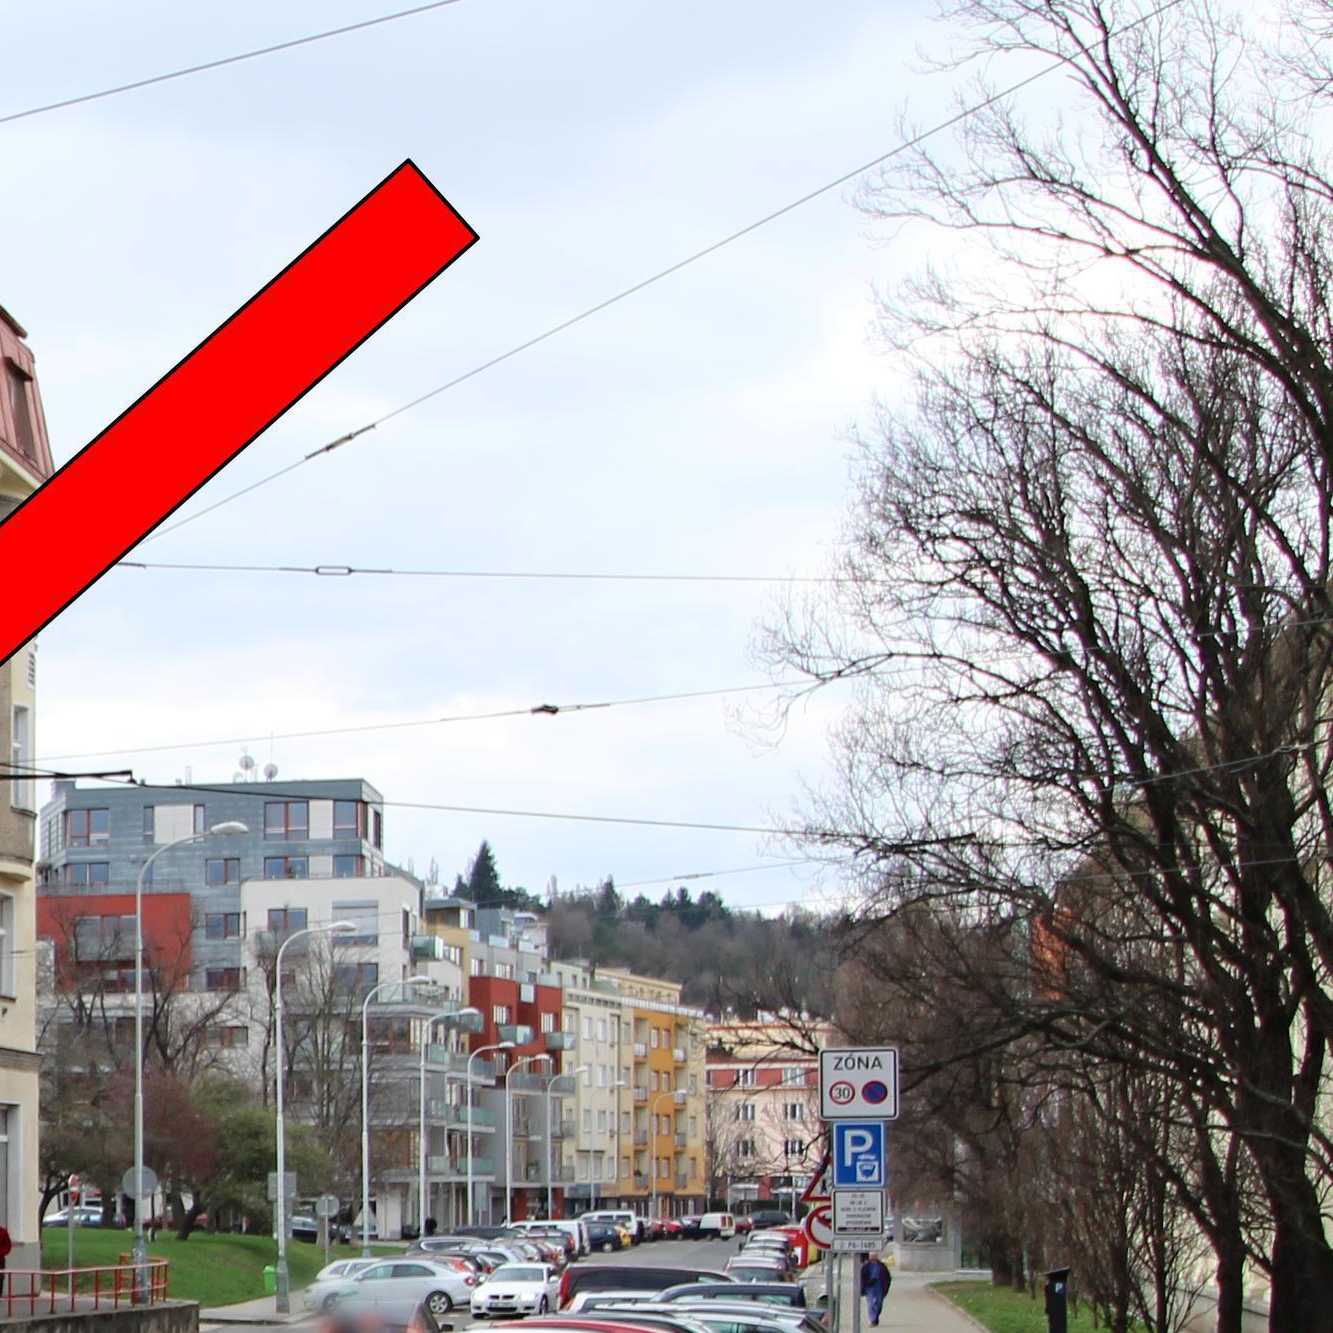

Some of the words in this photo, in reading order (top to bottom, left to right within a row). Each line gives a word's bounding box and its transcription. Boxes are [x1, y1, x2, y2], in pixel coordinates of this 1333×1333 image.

[834, 1053, 882, 1070] ZÓNA
[835, 1088, 850, 1099] 30
[844, 1129, 873, 1167] P
